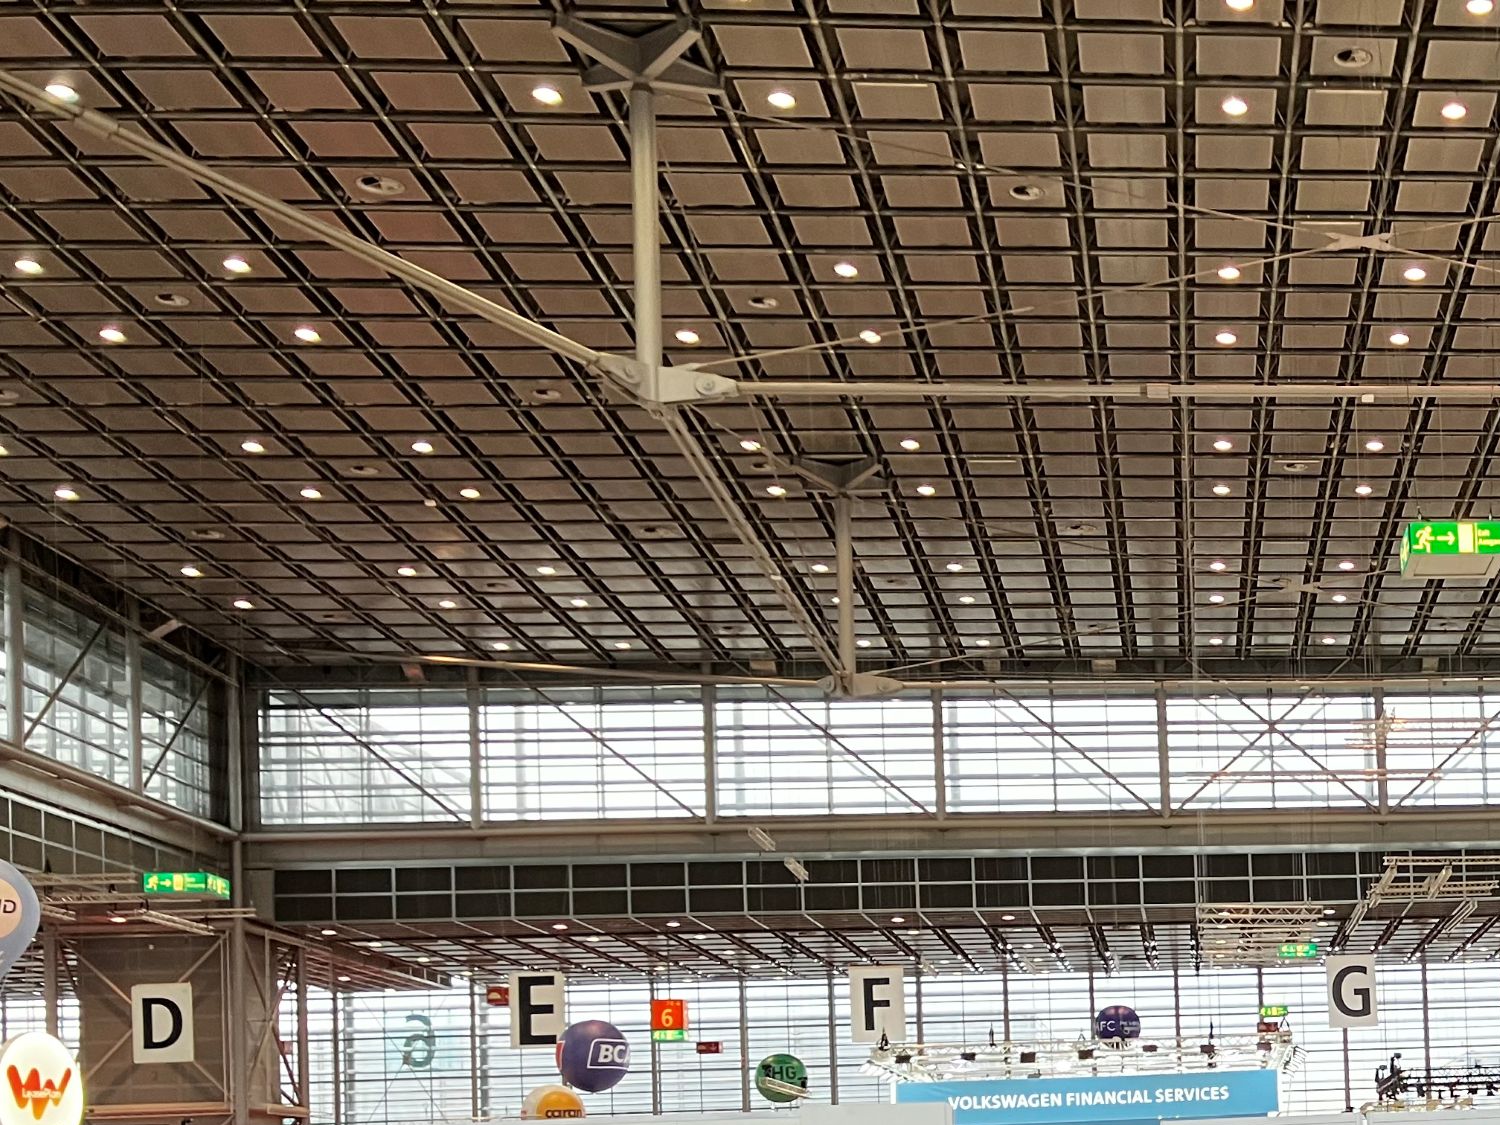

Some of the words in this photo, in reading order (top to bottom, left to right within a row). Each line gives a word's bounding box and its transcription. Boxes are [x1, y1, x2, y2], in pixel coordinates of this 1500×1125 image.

[518, 975, 557, 1045] E
[661, 1008, 674, 1027] 6
[863, 977, 890, 1031] F
[1332, 965, 1371, 1018] G
[142, 997, 182, 1050] D
[947, 1091, 1062, 1111] VOLKSWAGEN
[1065, 1089, 1153, 1107] FINANCIAL
[1154, 1085, 1230, 1104] SERVICES
